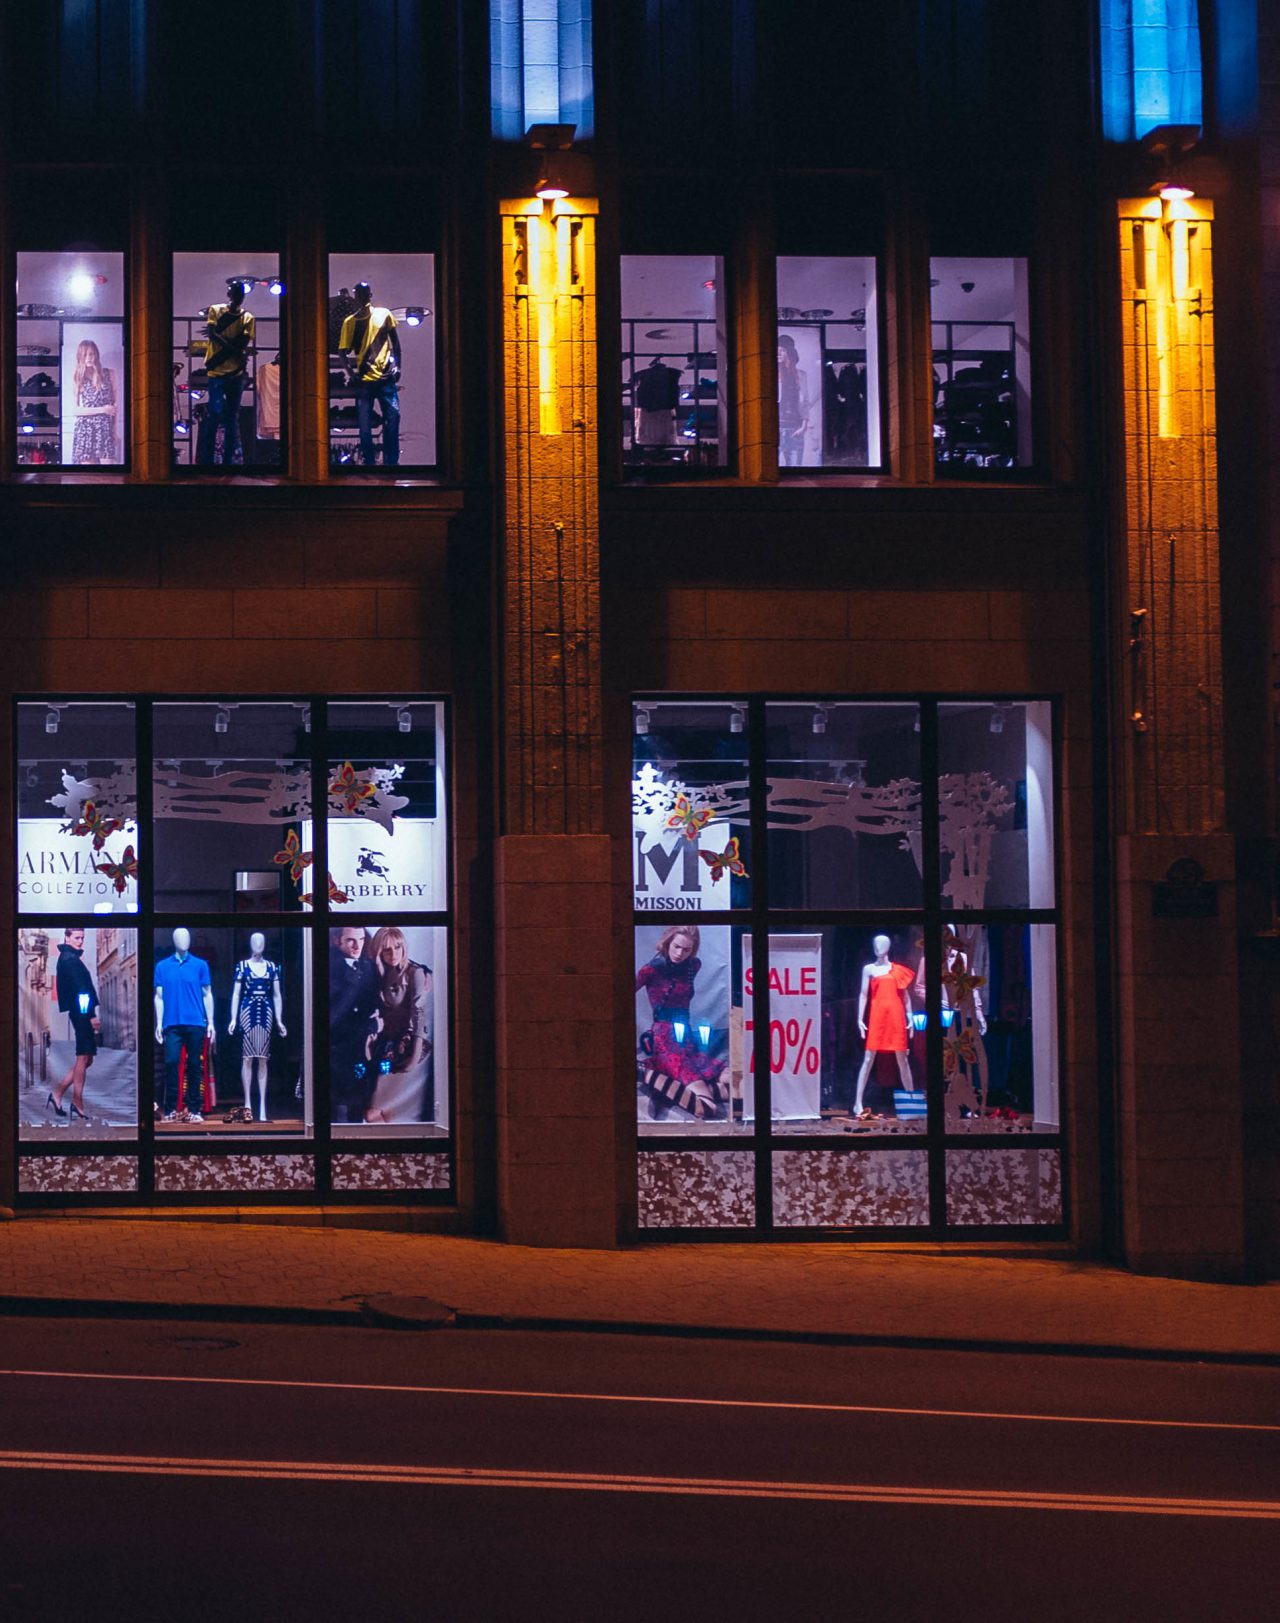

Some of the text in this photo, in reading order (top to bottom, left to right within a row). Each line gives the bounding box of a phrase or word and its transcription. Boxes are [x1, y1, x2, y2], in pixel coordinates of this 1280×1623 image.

[19, 851, 122, 875] ARMAN
[342, 884, 427, 897] RBERRY
[635, 897, 702, 910] MISSONI
